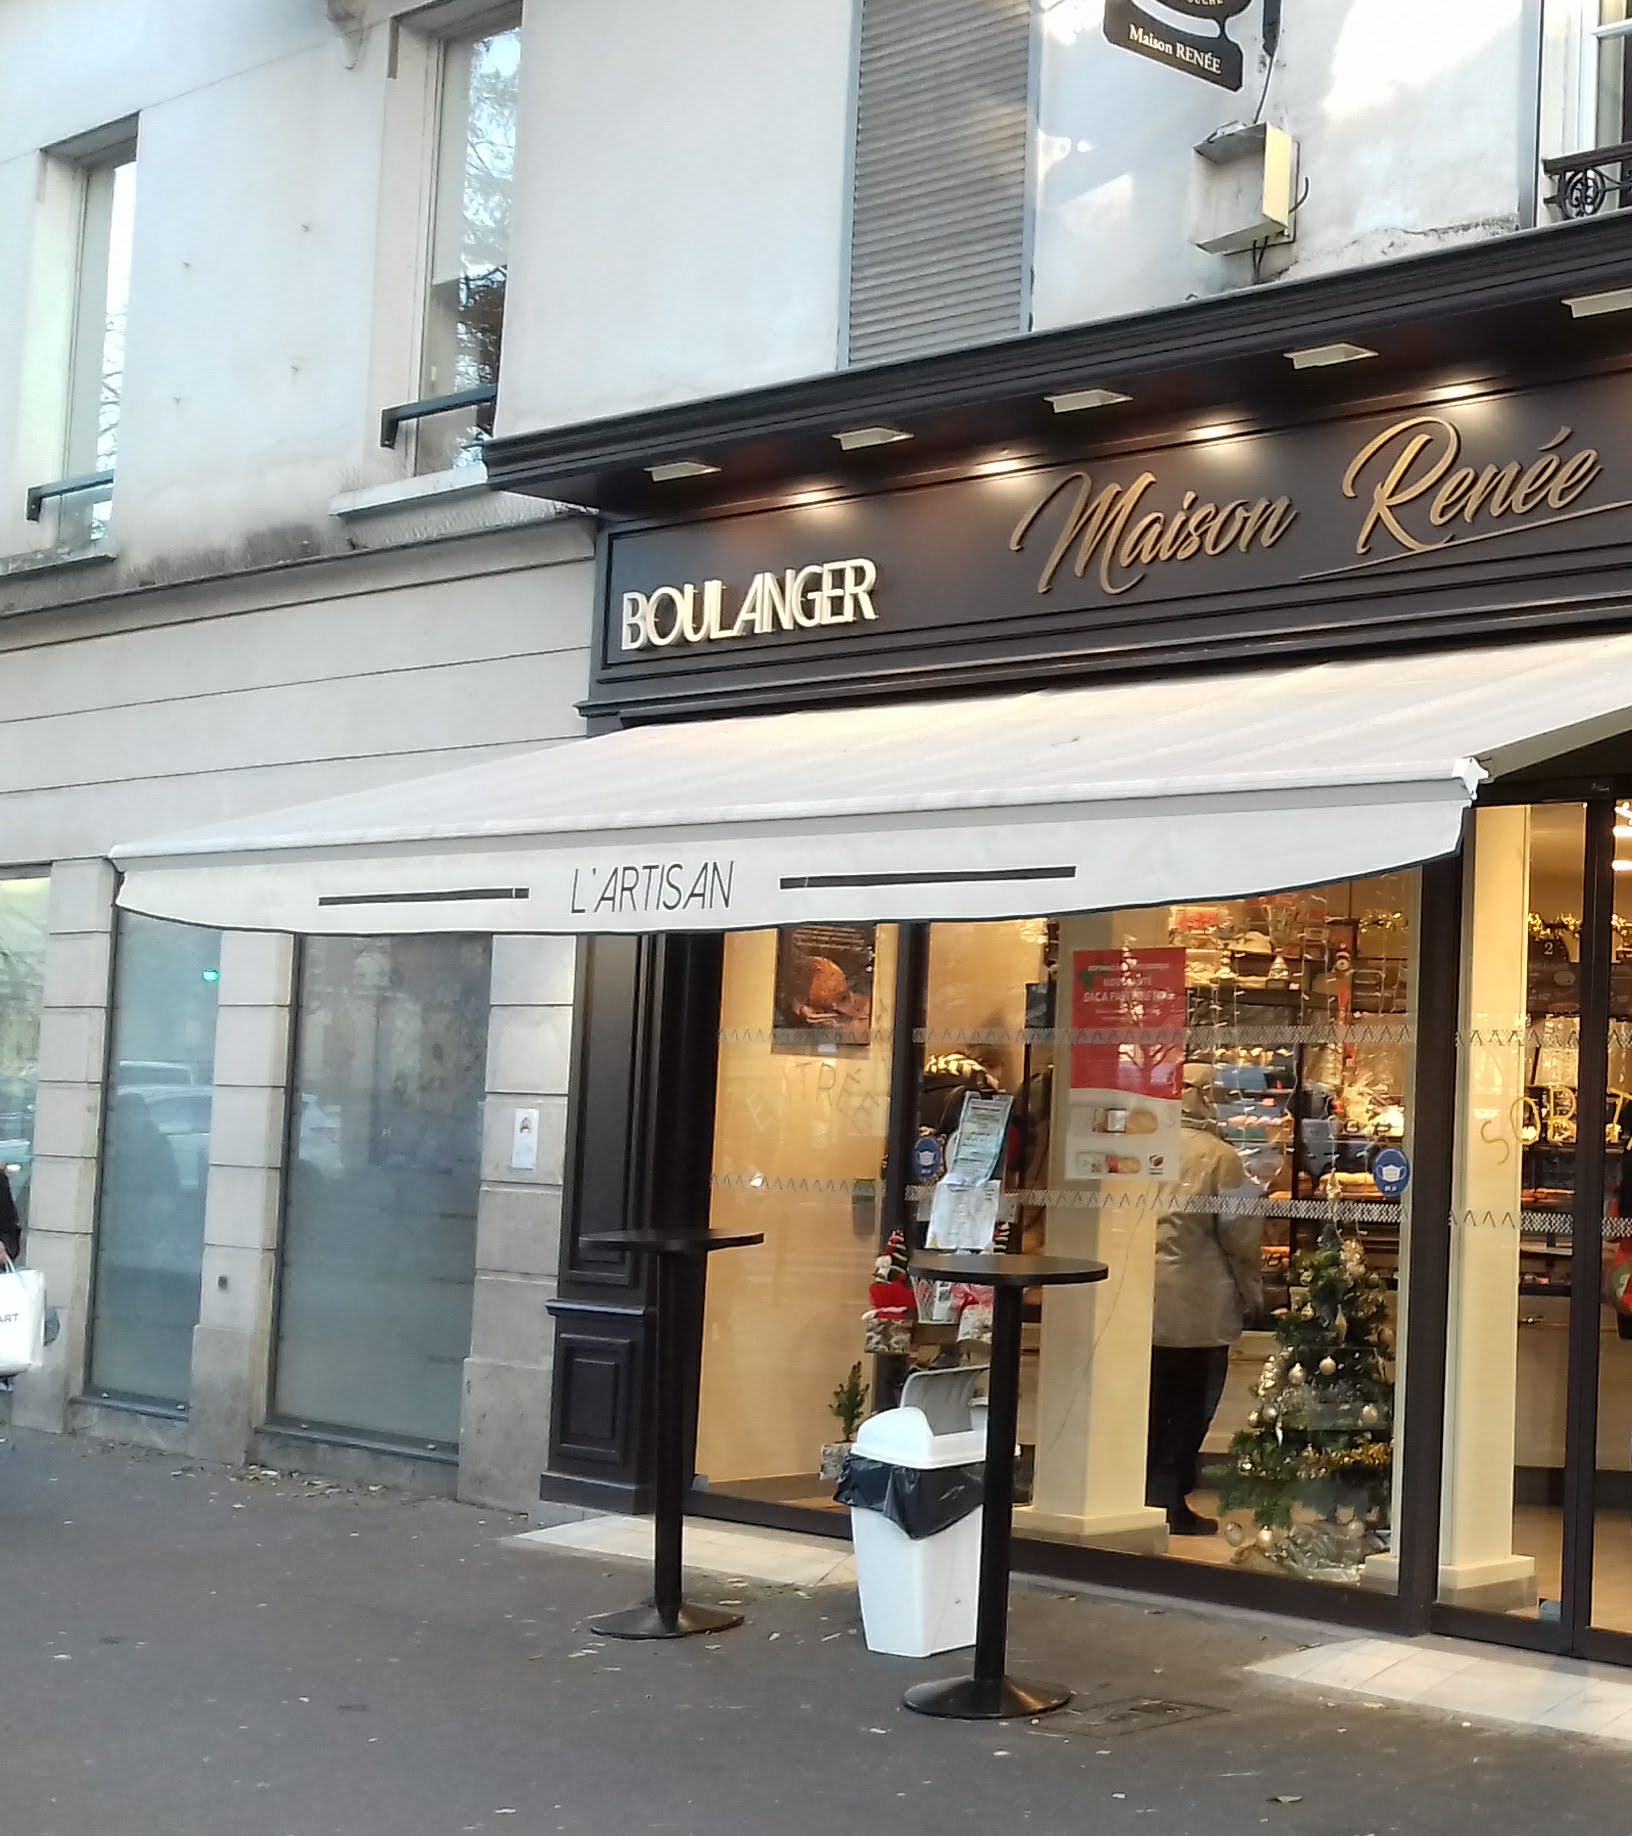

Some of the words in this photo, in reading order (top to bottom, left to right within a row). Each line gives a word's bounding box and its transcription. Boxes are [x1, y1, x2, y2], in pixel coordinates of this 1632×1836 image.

[1129, 24, 1173, 54] Maison
[1176, 43, 1222, 75] RENÉE
[1008, 470, 1299, 596] Maison
[1341, 414, 1603, 556] Renée
[621, 557, 880, 651] BOULANGER
[570, 860, 735, 914] L'ARTISAN
